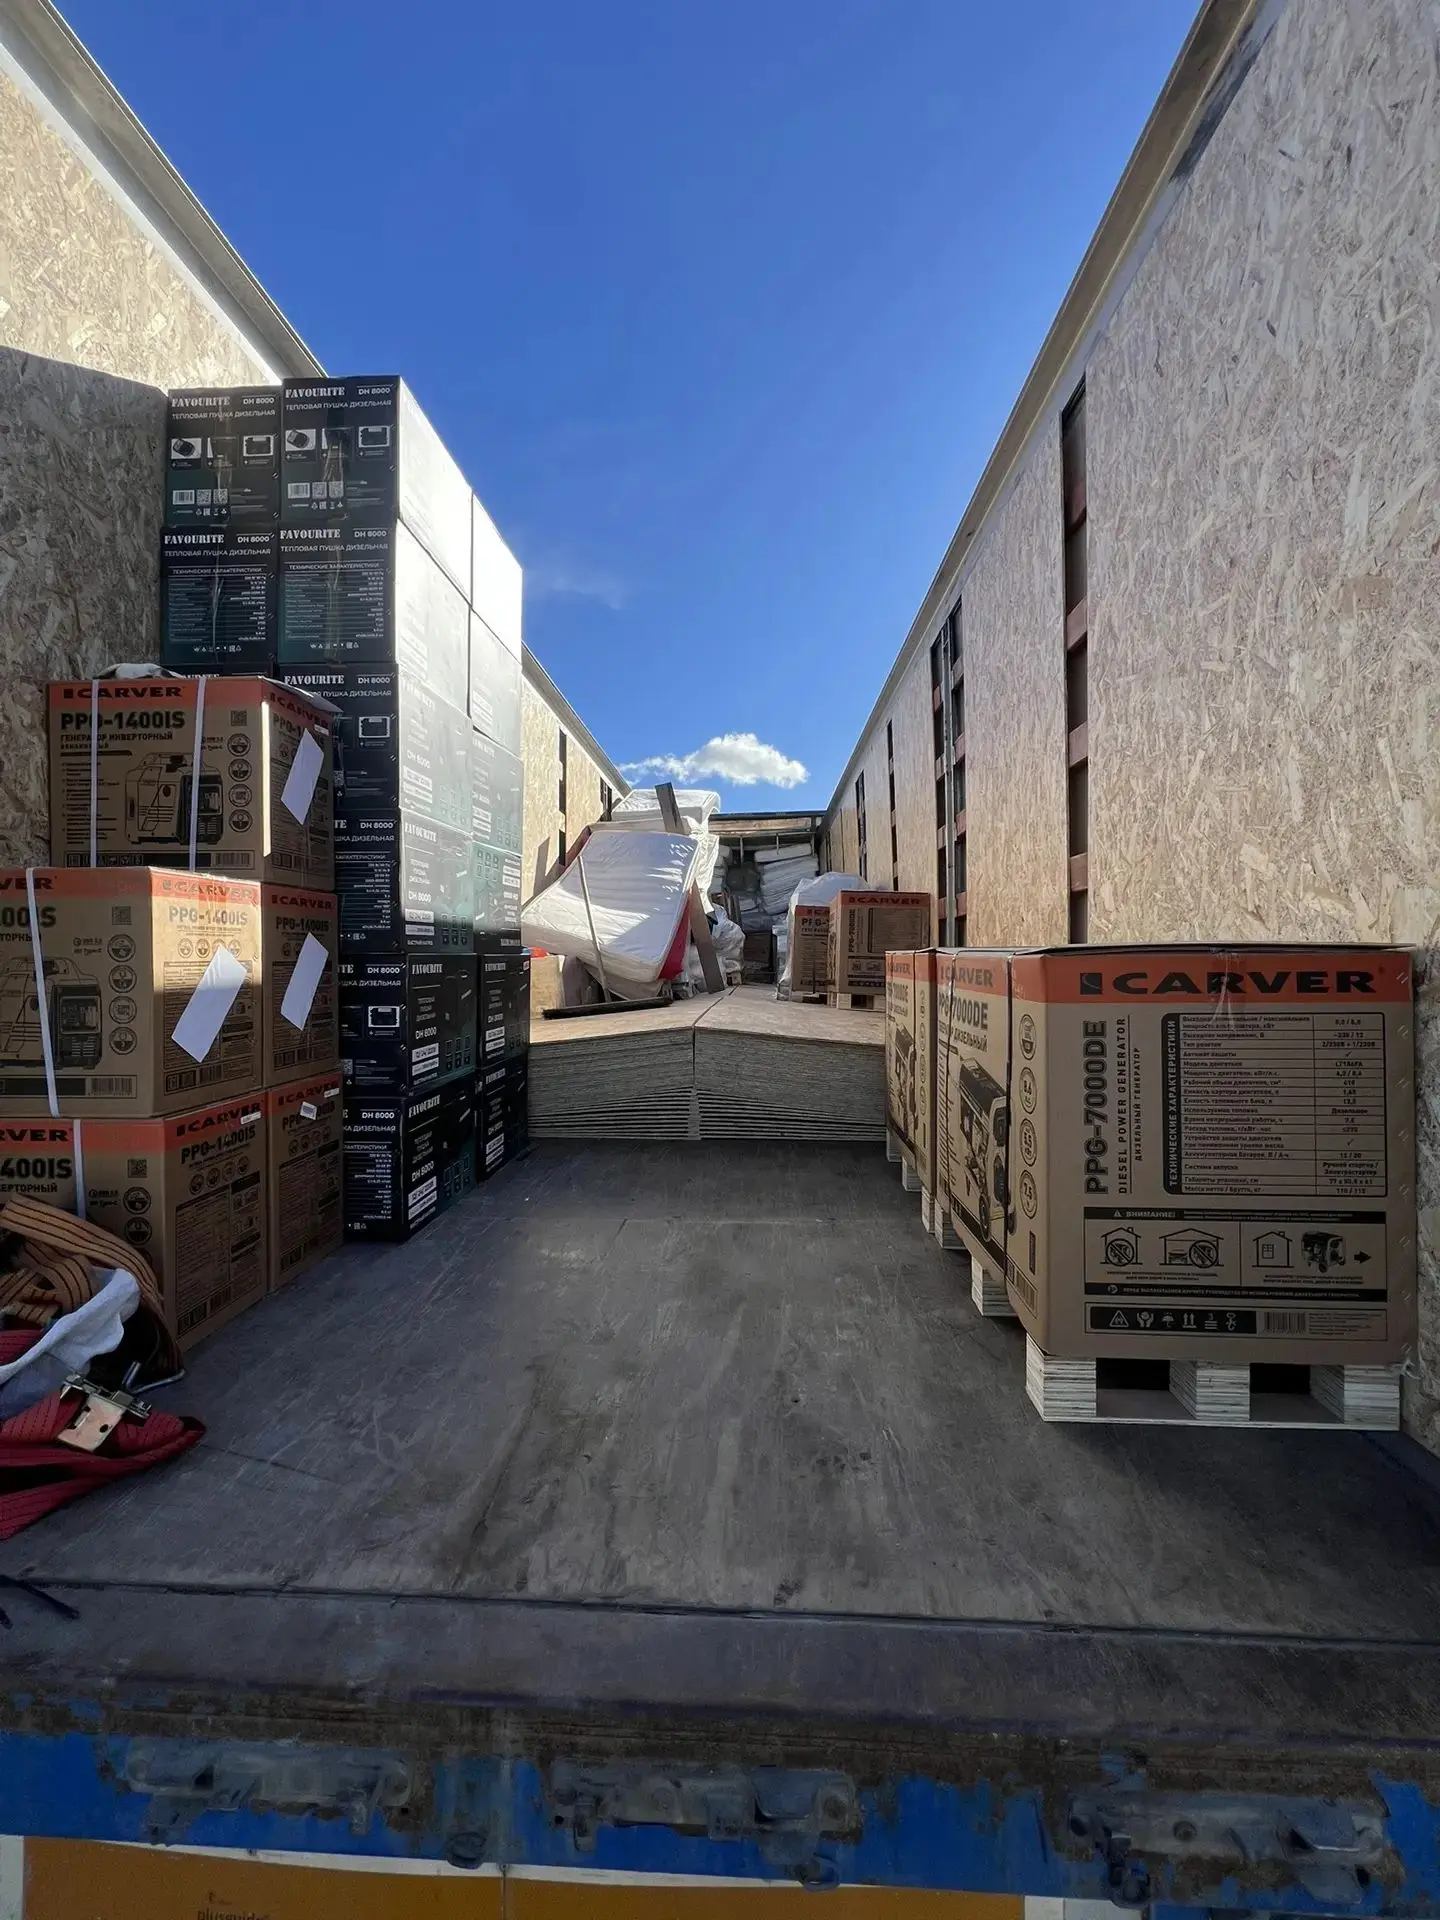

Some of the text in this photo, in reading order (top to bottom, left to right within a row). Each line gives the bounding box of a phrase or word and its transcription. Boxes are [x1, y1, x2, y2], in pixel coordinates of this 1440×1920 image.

[285, 387, 345, 398] FAVOURITE
[172, 396, 230, 408] FAVOURITE
[349, 400, 392, 408] ДИЗЕЛЬНАЯ
[172, 412, 208, 420] ТЕПЛОВАЯ
[234, 410, 276, 418] ДИЗЕЛЬНАЯ
[164, 534, 224, 544] FAVOURITE
[280, 528, 340, 540] FAVOURITE
[229, 548, 272, 556] ДИЗЕЛЬНАЯ
[284, 674, 344, 685] FAVOURITE
[371, 676, 390, 684] 8000
[77, 687, 182, 698] CARVER
[349, 690, 392, 698] ДИЗЕЛЬНАЯ
[60, 731, 173, 742] ГЕНЕРАОР ИНВЕРТОРНЫЙ
[175, 881, 252, 899] CARVER
[280, 896, 333, 910] CARVER
[169, 906, 248, 925] PPG-1400IS
[1112, 971, 1378, 994] CARVER
[416, 1026, 437, 1040] DH 8000
[1082, 1020, 1108, 1195] PPG-7000DE
[1117, 1018, 1128, 1194] DIESEL POWER GENERATOR
[1132, 1047, 1143, 1161] ДИЗЕЛЬНЫЙ ГЕНЕРАТОР
[1167, 1020, 1178, 1186] ТЕХНИЧЕСКИЕ ХАРАКТЕРИСТИКИ
[187, 1102, 261, 1132] CARVER
[0, 1128, 69, 1142] VER
[181, 1125, 256, 1164] PPG-1400IS
